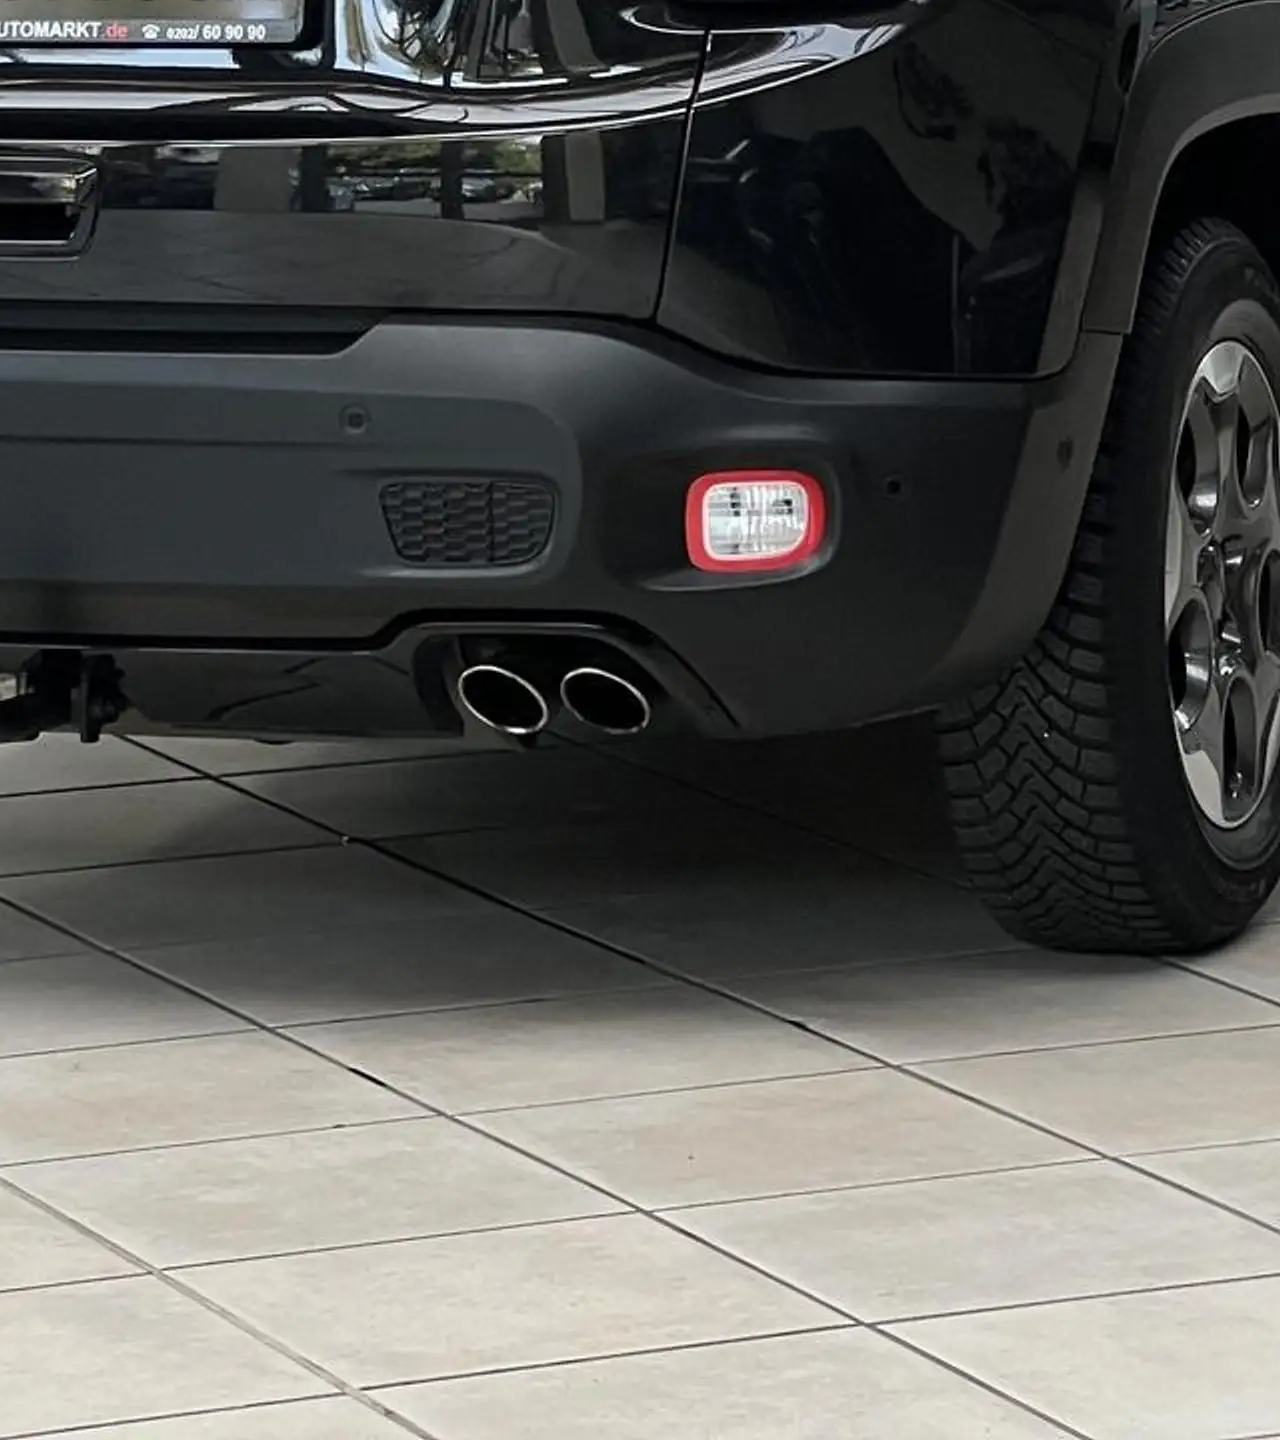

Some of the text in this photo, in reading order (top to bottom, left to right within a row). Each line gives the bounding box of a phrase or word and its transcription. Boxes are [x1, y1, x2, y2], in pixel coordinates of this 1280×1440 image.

[202, 24, 221, 40] 60
[223, 24, 244, 40] 90
[247, 24, 267, 40] 90
